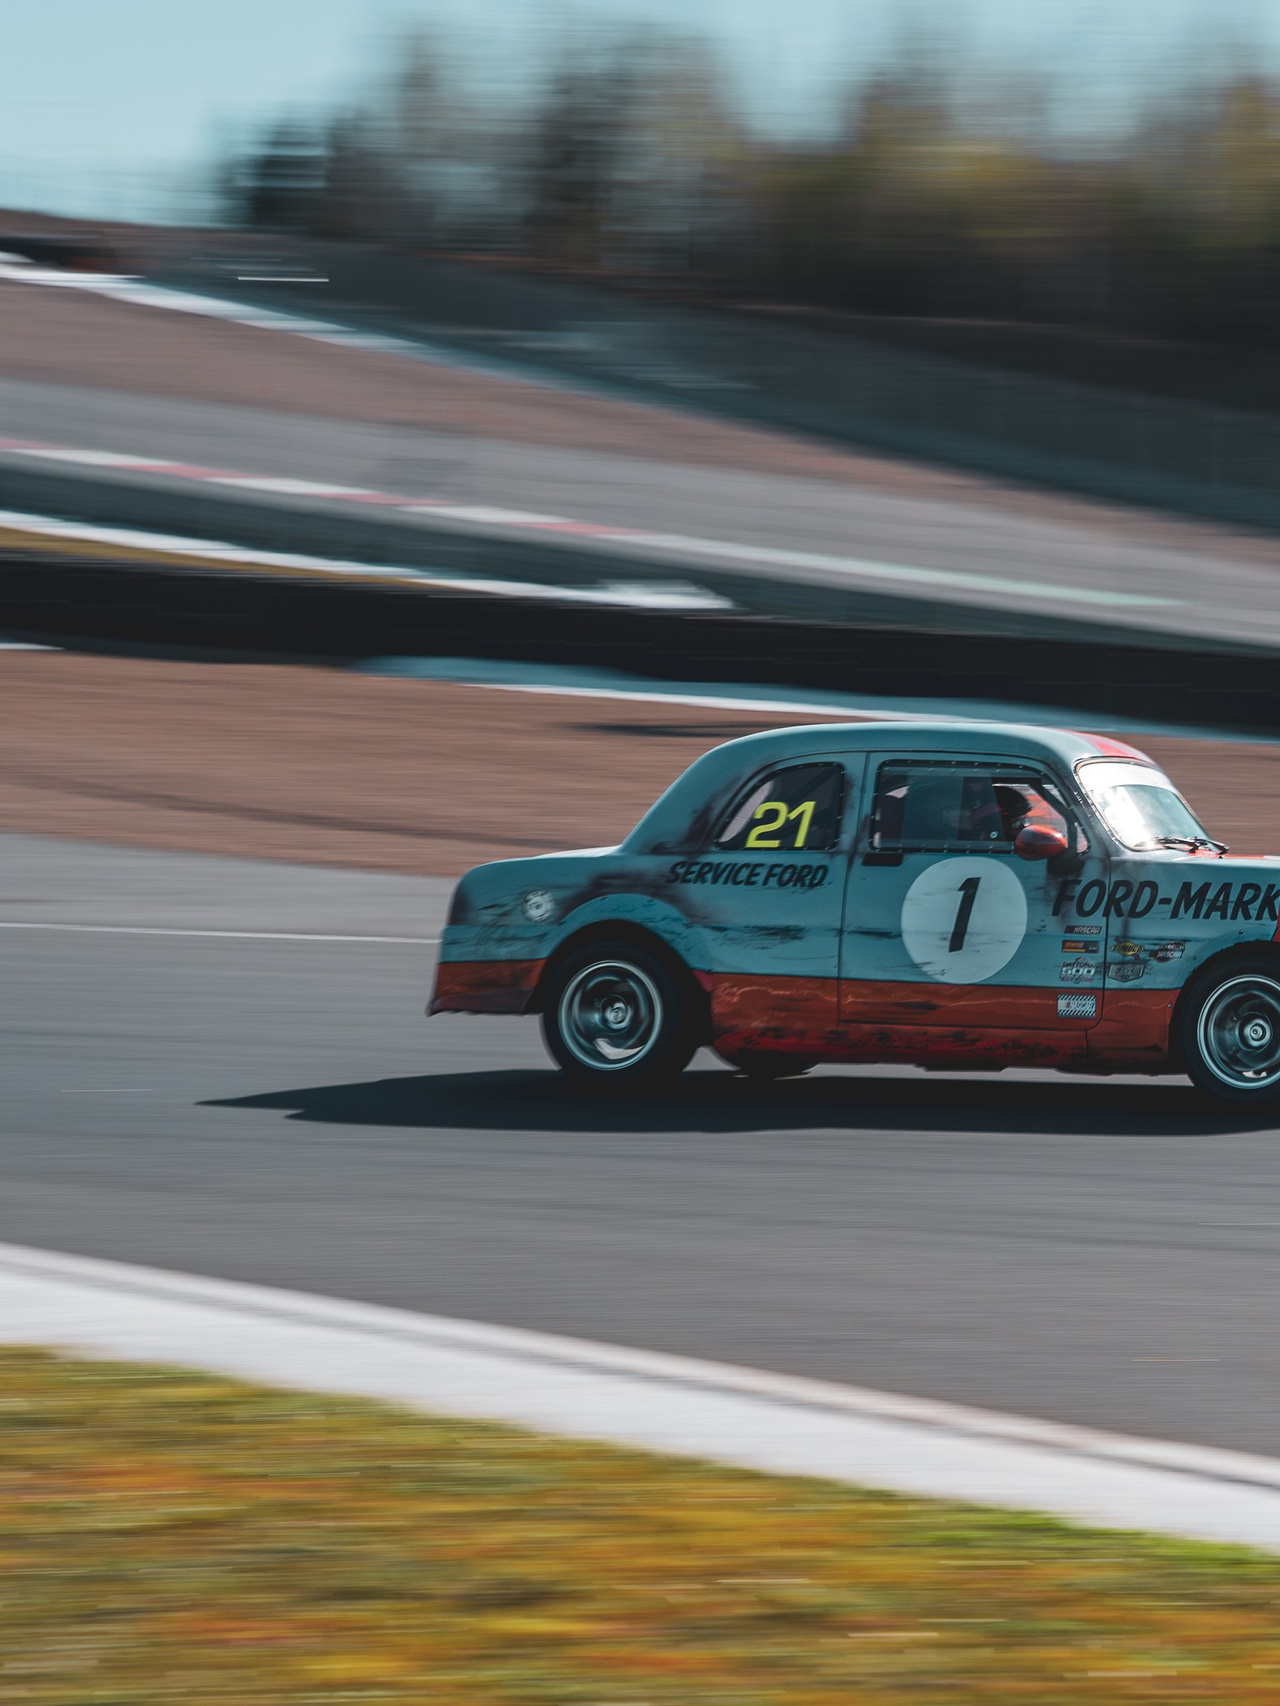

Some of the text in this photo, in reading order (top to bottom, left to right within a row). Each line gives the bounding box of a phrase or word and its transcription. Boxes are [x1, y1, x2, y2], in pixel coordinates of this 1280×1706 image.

[745, 801, 816, 848] 21
[667, 861, 828, 888] SERVICE FORD
[948, 876, 981, 953] 1
[1073, 926, 1100, 935] NASCAR
[1111, 944, 1144, 953] SUNOCO
